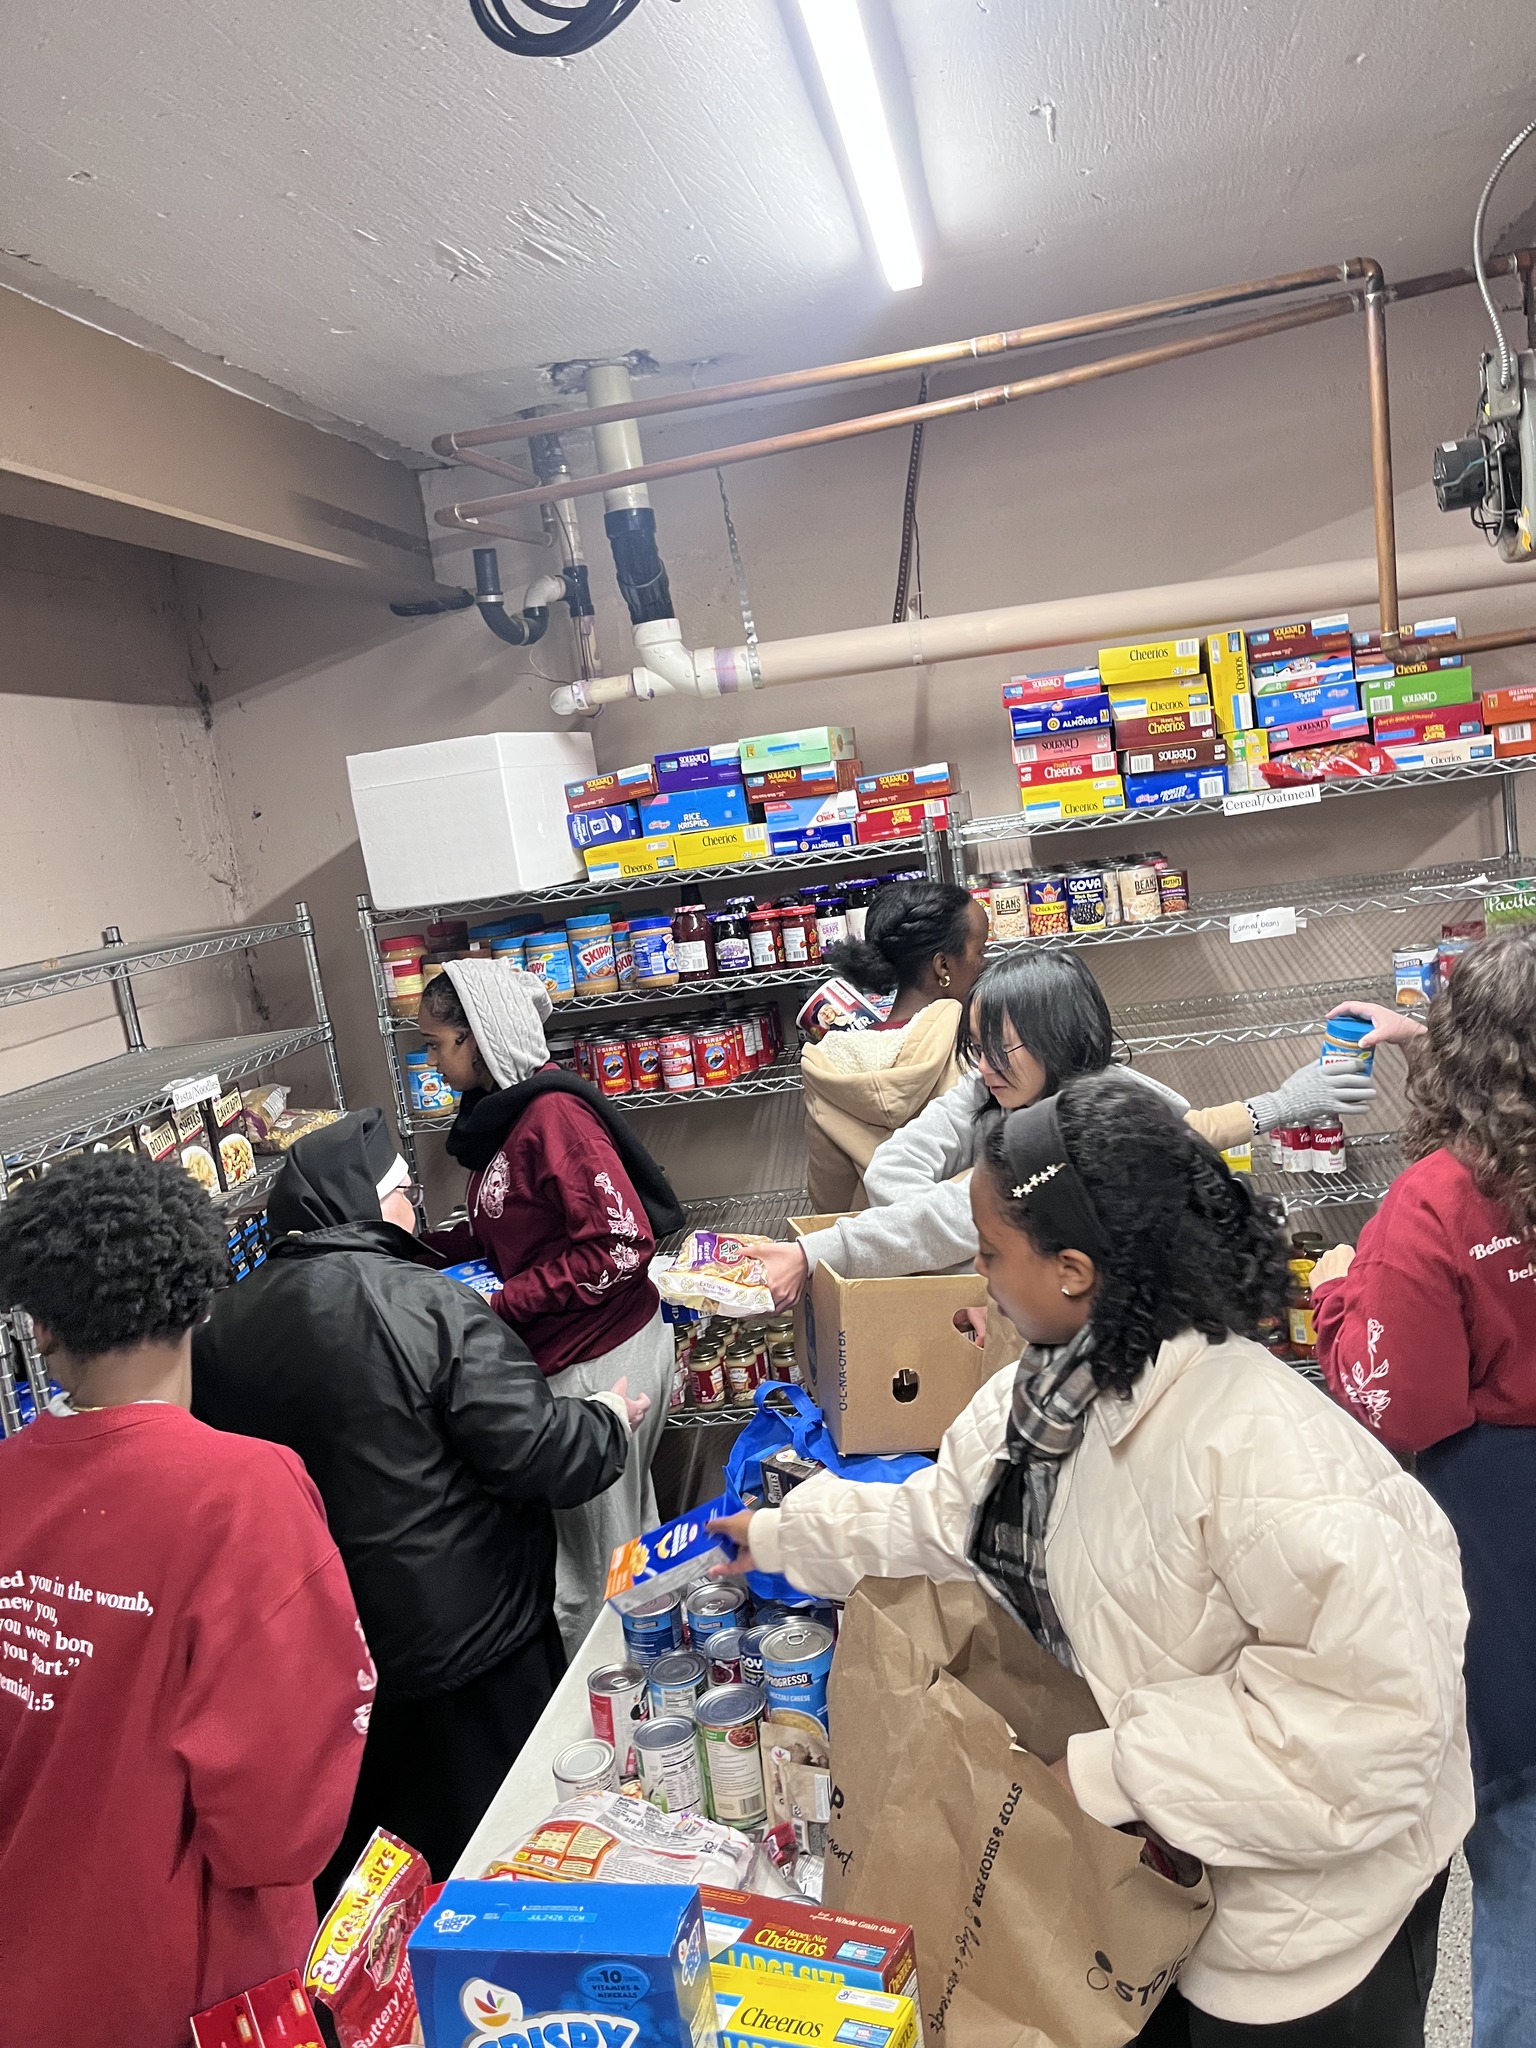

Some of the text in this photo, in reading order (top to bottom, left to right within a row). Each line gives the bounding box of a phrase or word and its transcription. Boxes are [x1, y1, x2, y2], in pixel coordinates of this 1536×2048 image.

[1273, 624, 1306, 637] Cheerios
[1129, 646, 1169, 662] Cheerios
[1235, 656, 1243, 691] Cheerios
[1396, 661, 1428, 675] Cheerios
[1150, 701, 1183, 712] Cheerios
[1062, 716, 1098, 728] ALMONDS
[1148, 721, 1185, 735] Cheerios
[1042, 738, 1079, 750] Cheerios
[1158, 748, 1197, 762] Cheerios
[1431, 754, 1462, 765] Cheerios
[767, 769, 797, 780] Cheerios
[879, 772, 909, 784] Cheerios
[1044, 765, 1082, 779] Cheerios
[1225, 787, 1315, 811] Cereal/Oatmeal
[1064, 803, 1098, 814] Cheerios
[683, 812, 701, 821] RICE
[816, 813, 836, 823] Chex
[677, 819, 709, 831] KRISPIES
[702, 835, 738, 847] Cheerios
[811, 841, 839, 851] ALMONDS
[623, 862, 653, 875] Cheerios
[1069, 878, 1102, 892] GOYA
[995, 899, 1021, 910] BEANS
[1489, 893, 1536, 913] Pacific
[1260, 920, 1280, 928] beans
[582, 945, 611, 966] SKIPPY
[174, 1079, 220, 1106] Pasta/Noodles
[216, 1093, 242, 1122] CAVATAPPI
[179, 1110, 201, 1136] SHELLS
[150, 1128, 175, 1156] ROTINI
[0, 1570, 154, 1616] ed you in the womb,
[0, 1596, 58, 1627] new you,
[3, 1641, 28, 1661] you
[55, 1630, 94, 1658] born
[998, 1782, 1023, 1826] STOP
[992, 1826, 1005, 1838] &
[978, 1837, 1001, 1881] SHOP
[368, 1847, 397, 1887] SIZE
[835, 1916, 897, 1935] Whole Grain Oats
[754, 1929, 827, 1957] Cheerios
[786, 1929, 828, 1944] Honey Nut
[599, 1970, 622, 1984] 10
[740, 2007, 824, 2038] Cheerios
